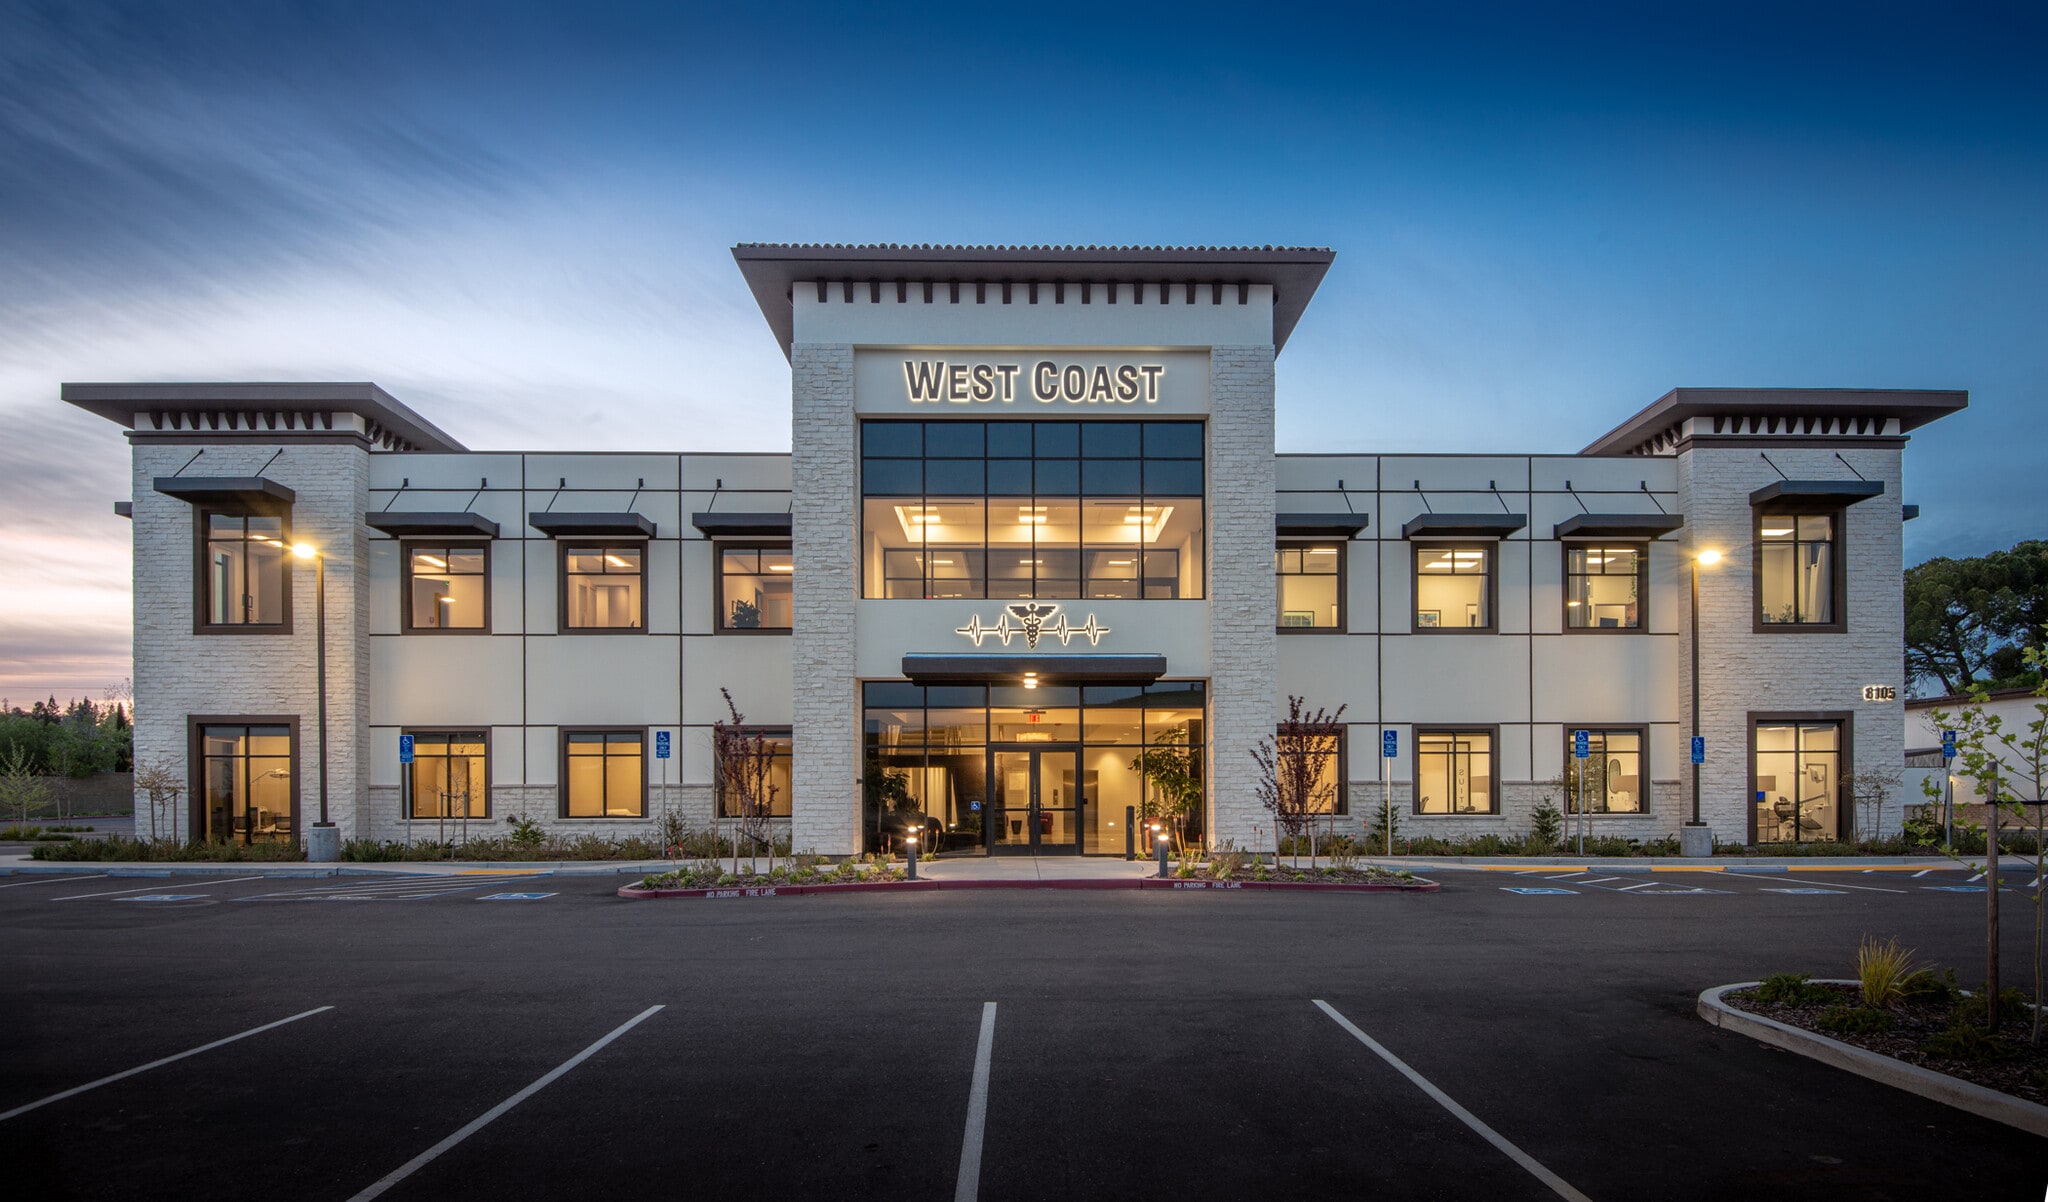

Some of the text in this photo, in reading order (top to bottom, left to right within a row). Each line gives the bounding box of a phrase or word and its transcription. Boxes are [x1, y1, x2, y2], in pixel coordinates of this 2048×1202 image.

[904, 361, 1163, 401] WEST COAST
[1864, 686, 1896, 700] 8105
[716, 890, 740, 898] PARKING
[745, 889, 759, 897] FIRE
[761, 888, 776, 896] LANE
